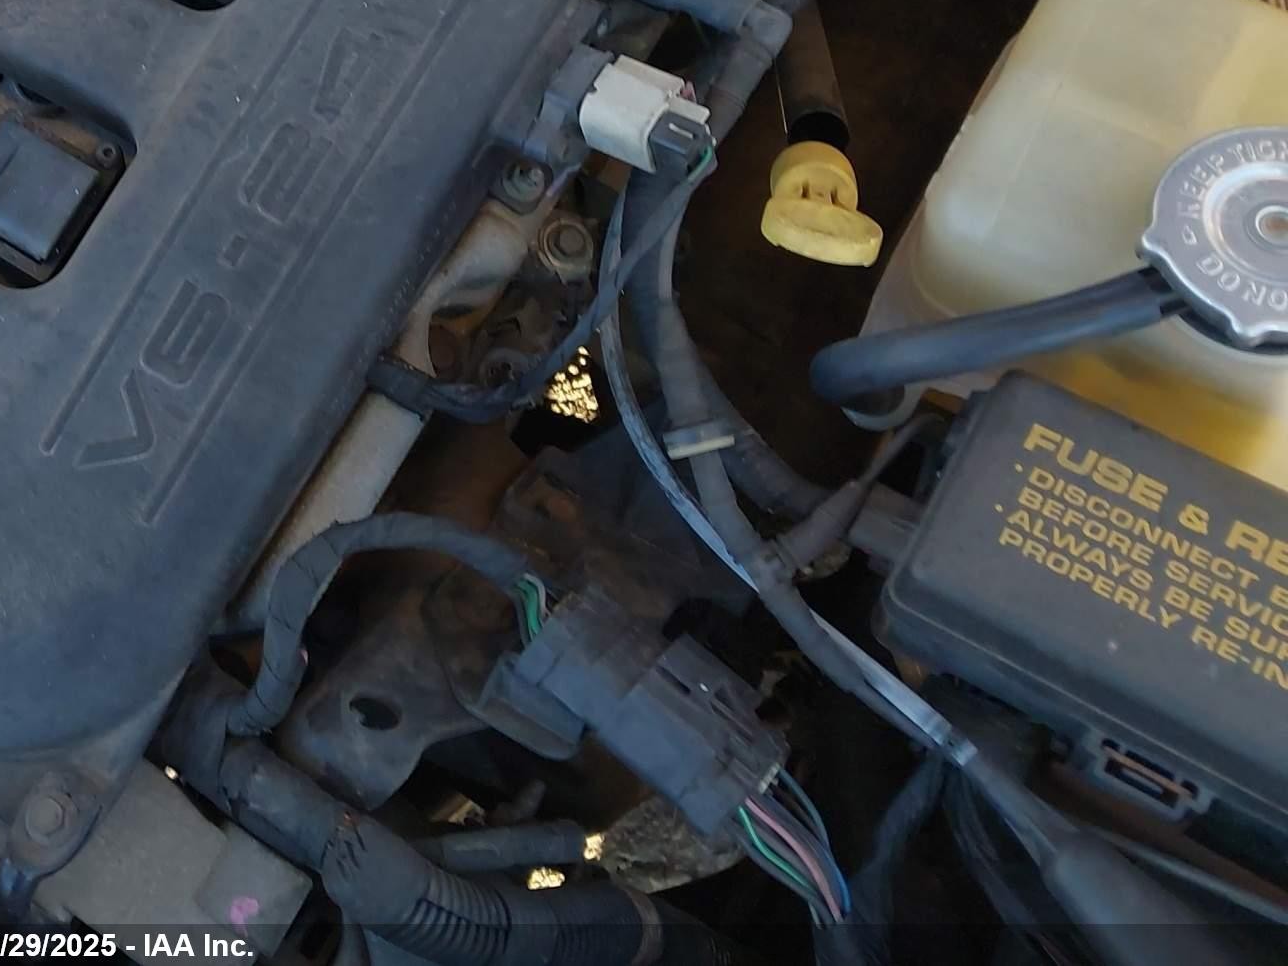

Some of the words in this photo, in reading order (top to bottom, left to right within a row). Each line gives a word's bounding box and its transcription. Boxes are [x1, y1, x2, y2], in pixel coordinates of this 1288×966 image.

[1176, 153, 1224, 219] KEEP
[1196, 254, 1241, 292] DO
[1017, 487, 1154, 568] BEFORE
[1023, 423, 1168, 513] FUSE
[1178, 503, 1210, 536] &
[1028, 466, 1260, 589] DISCONNECT
[998, 526, 1182, 631] PROPERLY
[1008, 510, 1154, 592] ALWAYS
[1165, 585, 1213, 624] BE
